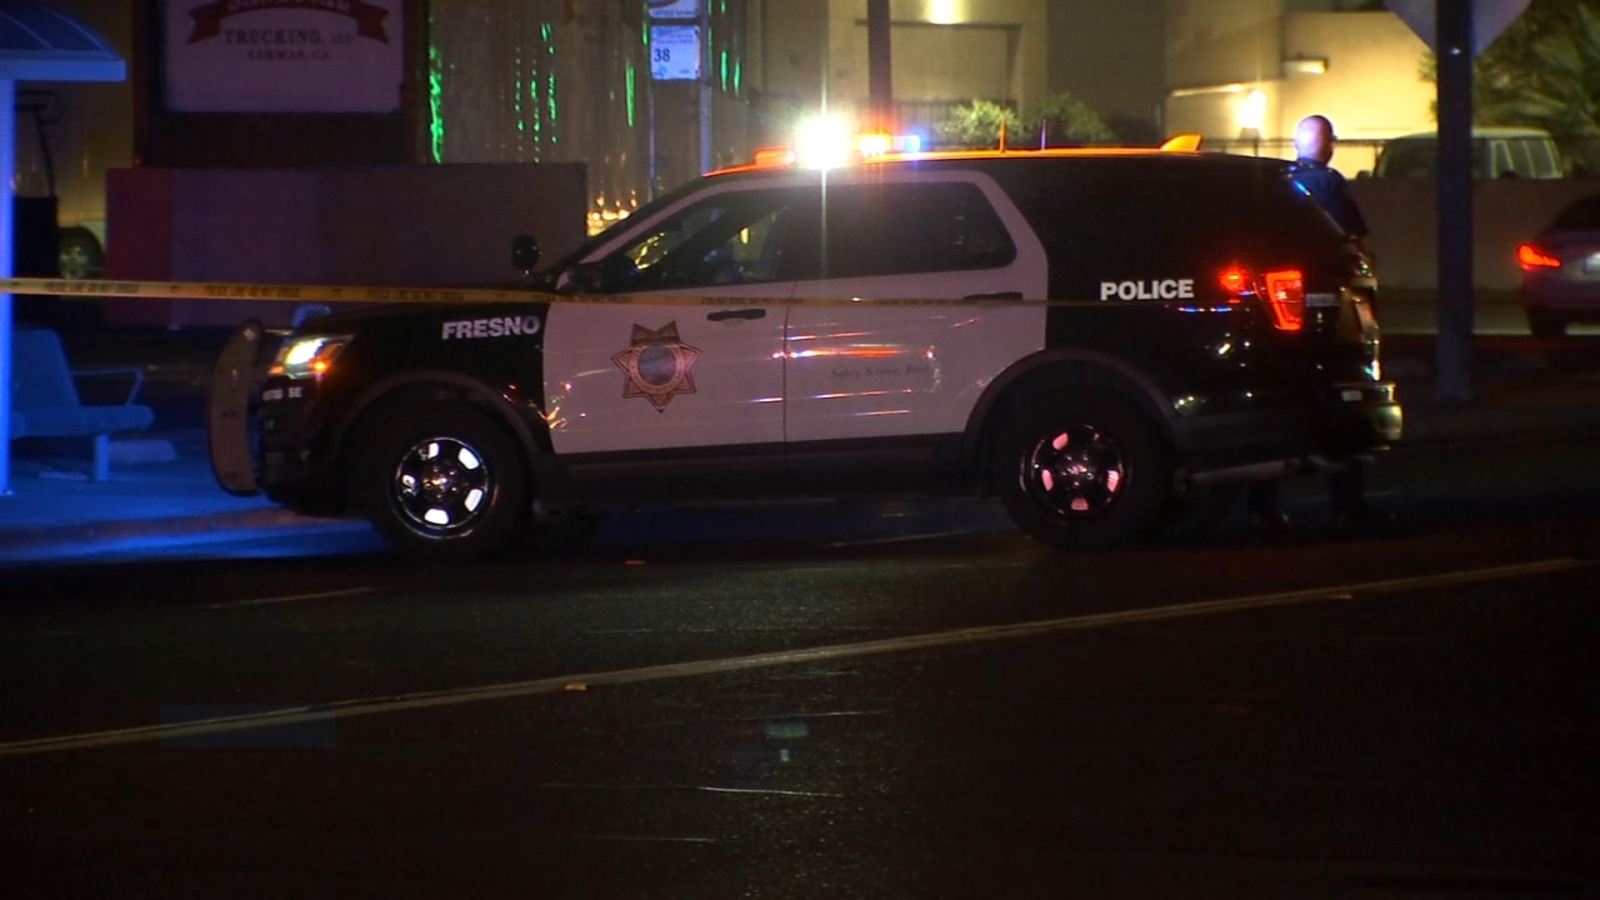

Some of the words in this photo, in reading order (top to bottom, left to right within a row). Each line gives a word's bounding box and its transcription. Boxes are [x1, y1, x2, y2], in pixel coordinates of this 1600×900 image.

[653, 47, 671, 63] 38
[1100, 279, 1195, 301] POLICE
[441, 315, 541, 340] FRESNO
